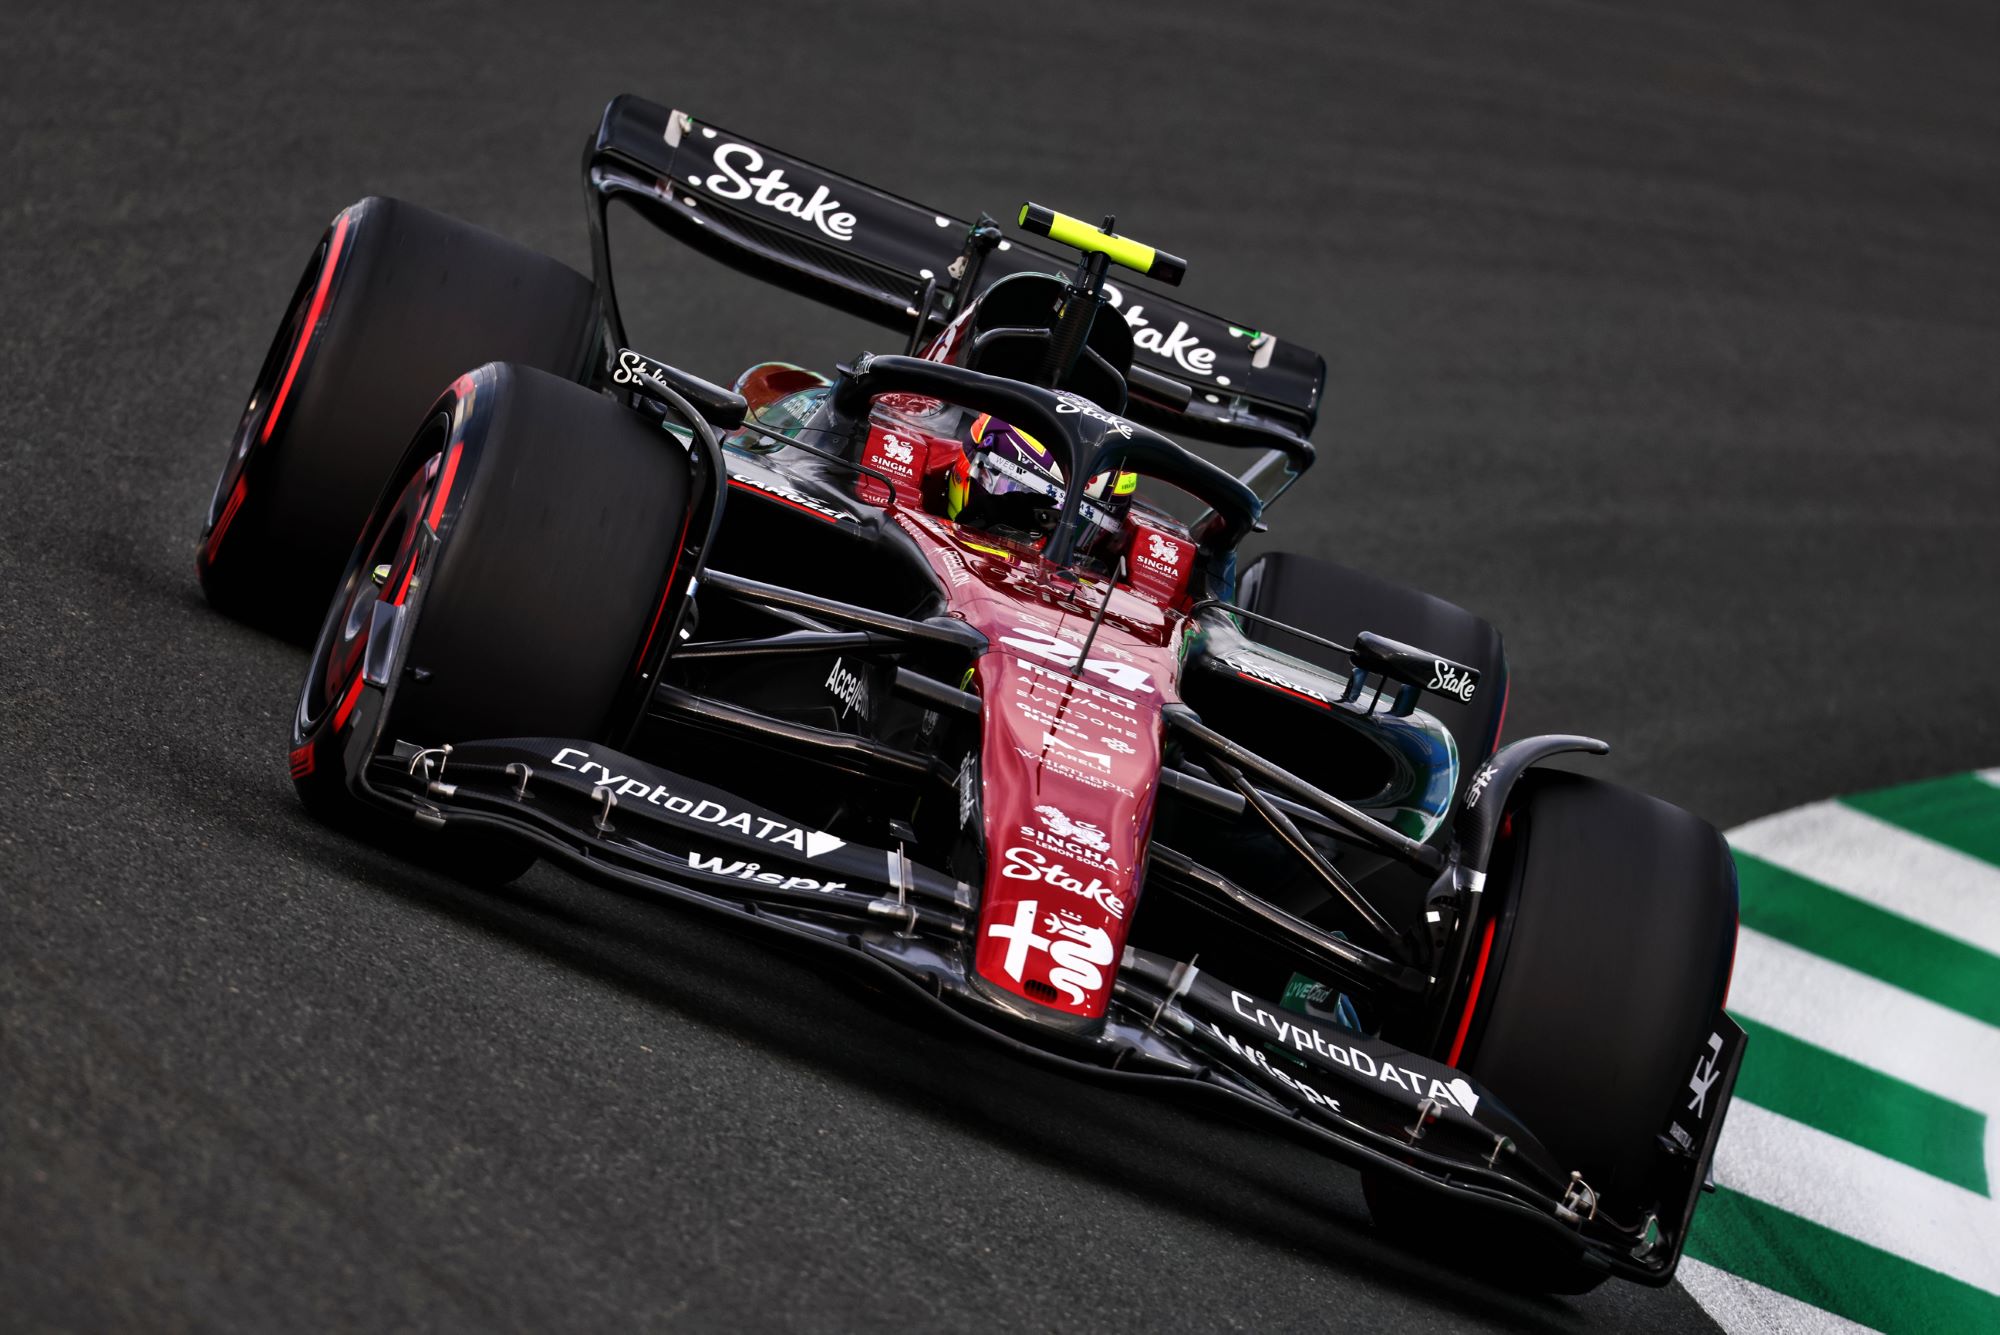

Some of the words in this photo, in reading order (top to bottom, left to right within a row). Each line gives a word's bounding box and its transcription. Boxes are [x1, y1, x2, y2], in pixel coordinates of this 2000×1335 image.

[706, 143, 857, 241] Stake
[1056, 396, 1133, 440] Stake
[871, 455, 913, 476] SINGHA
[1137, 555, 1178, 577] SINGHA
[998, 627, 1155, 693] 24
[1427, 660, 1476, 702] Stake
[1017, 658, 1137, 710] PIRELLI
[1043, 745, 1111, 774] MARELLI
[551, 748, 805, 851] CryptoDATA
[1020, 825, 1119, 870] SINGHA
[1035, 840, 1075, 860] LEMON
[1076, 855, 1107, 872] SODA
[688, 852, 847, 894] Wispr
[1002, 847, 1125, 920] Stake
[1231, 991, 1459, 1107] CryptoDATA
